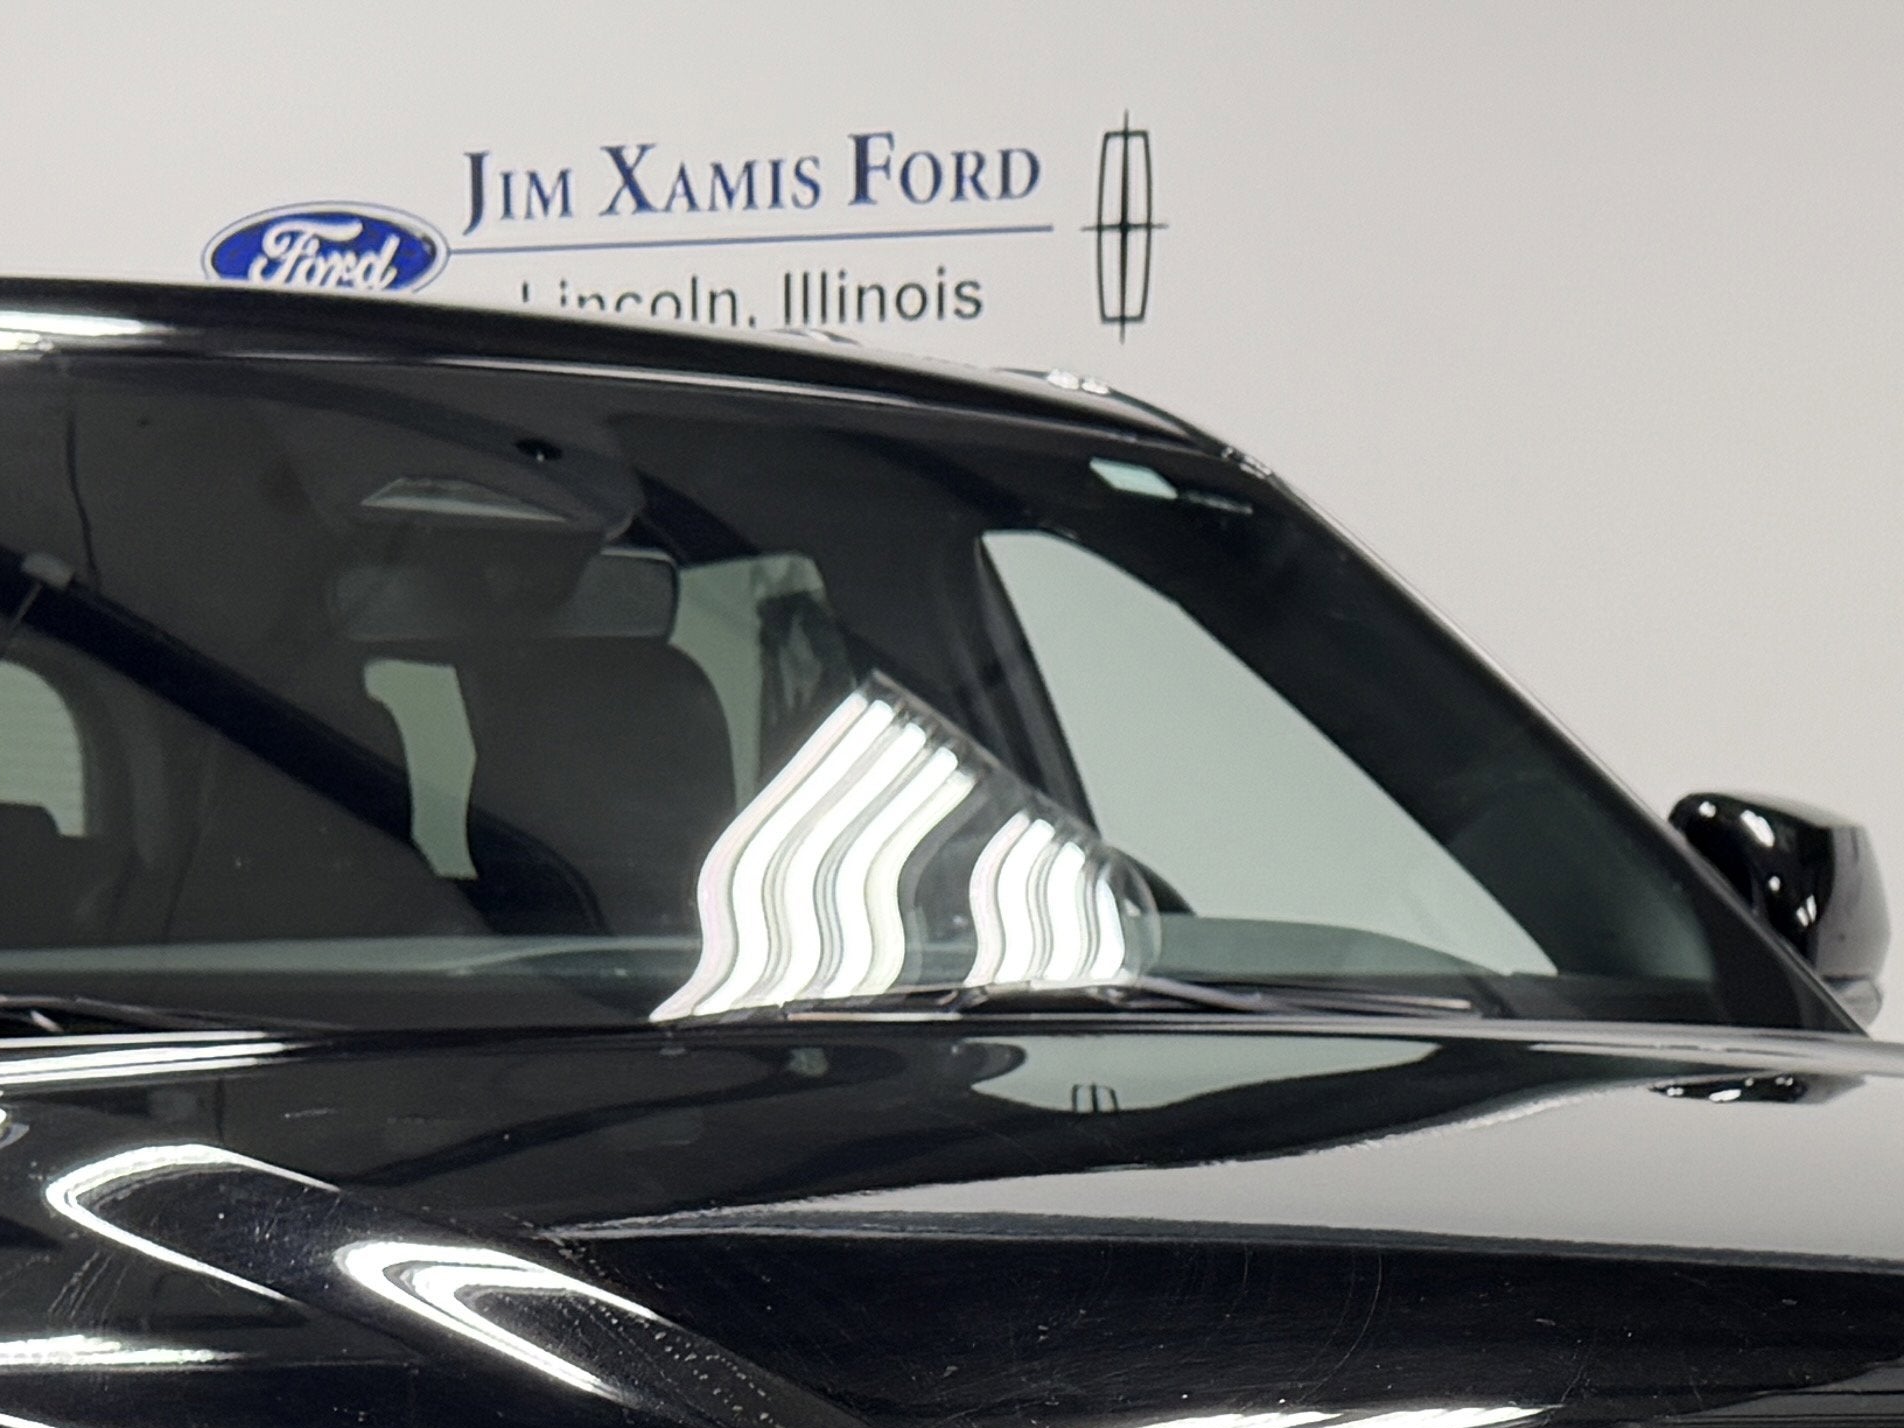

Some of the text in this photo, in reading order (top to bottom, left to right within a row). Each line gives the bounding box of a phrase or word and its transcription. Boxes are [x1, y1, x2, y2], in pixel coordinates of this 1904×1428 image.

[462, 131, 1042, 236] JIM XAMIS FORD
[248, 218, 400, 289] Ford
[783, 266, 984, 327] Illinois
